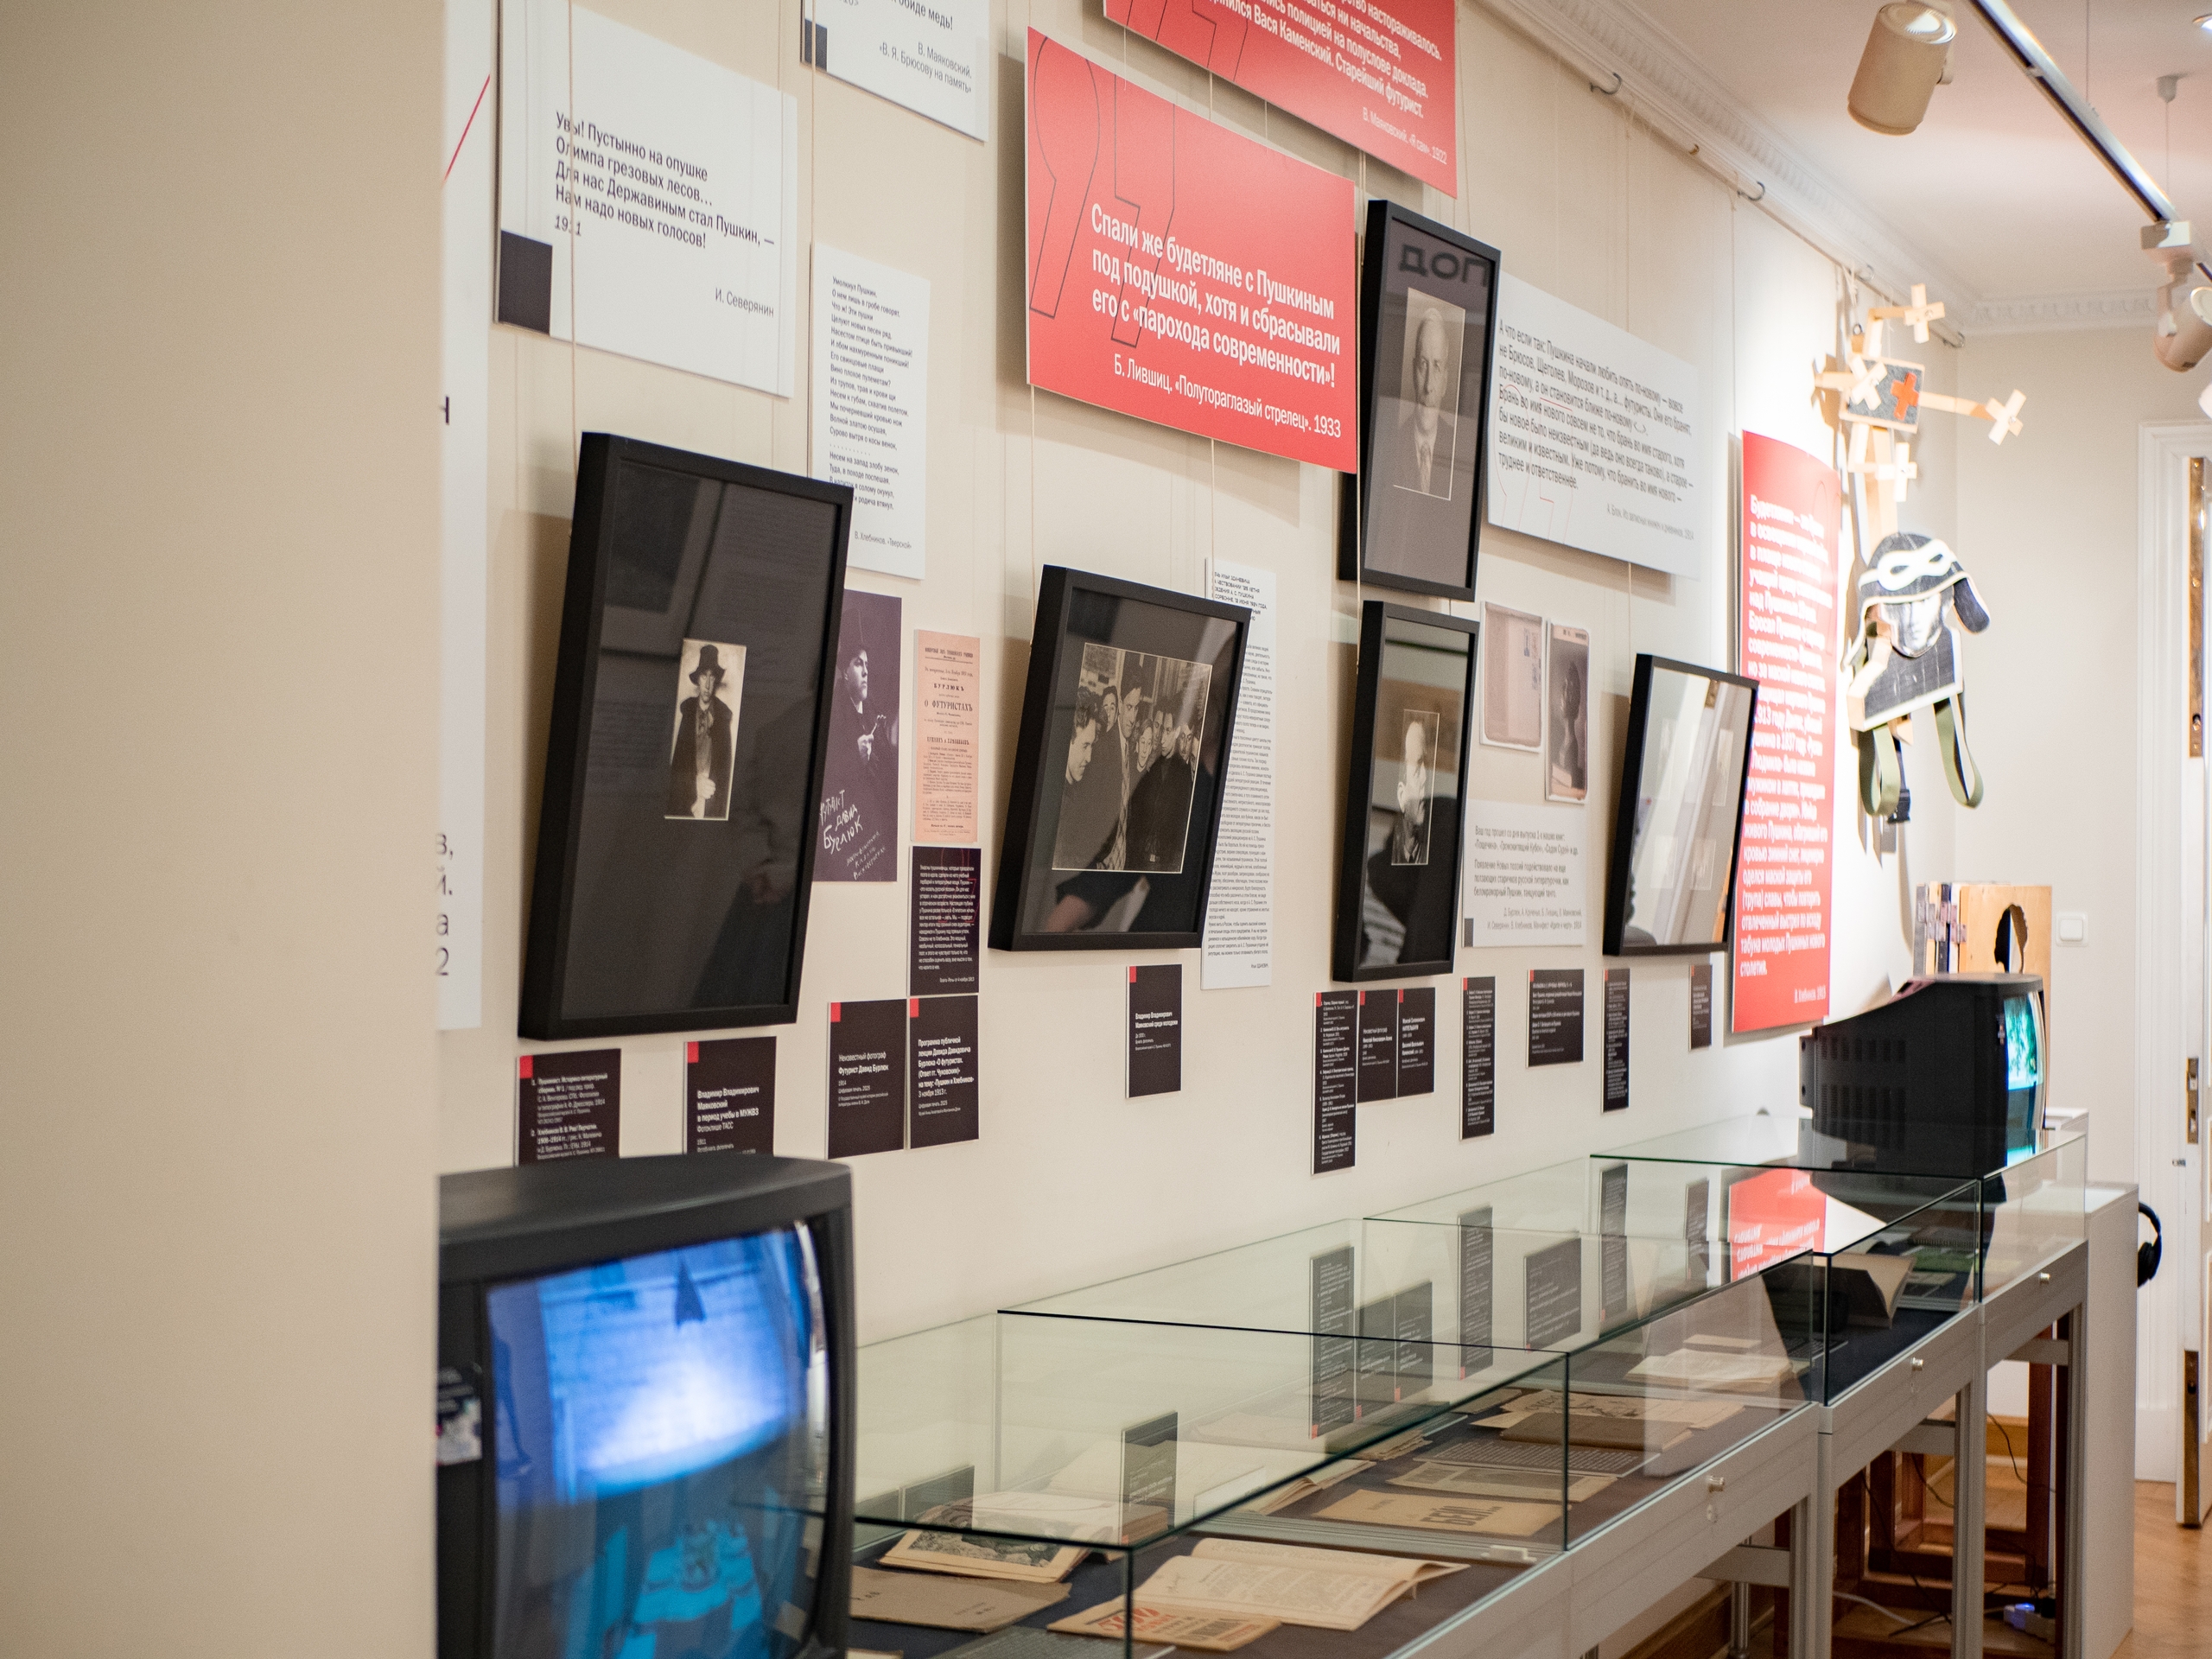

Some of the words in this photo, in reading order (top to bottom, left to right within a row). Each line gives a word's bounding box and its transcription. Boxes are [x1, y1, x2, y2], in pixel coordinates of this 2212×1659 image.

[1287, 3, 1332, 41] полицией
[1334, 30, 1345, 49] на
[1346, 38, 1391, 74] полуслове
[1392, 66, 1428, 99] доклада.
[1336, 7, 1349, 24] ни
[1350, 16, 1402, 61] начальства,
[1367, 3, 1442, 61] настораживалось.
[1254, 7, 1278, 35] Вася
[1280, 21, 1334, 67] Каменский.
[1335, 53, 1384, 96] Старейший
[1385, 82, 1424, 118] футурист.
[588, 123, 646, 159] Пустынно
[649, 149, 663, 165] на
[665, 156, 708, 181] опушке
[1363, 106, 1370, 123] В.
[1370, 111, 1409, 144] Маяковский.
[607, 158, 664, 189] грезовых
[555, 214, 582, 237] 191
[583, 174, 604, 192] нас
[607, 178, 686, 219] Державиным
[689, 210, 713, 228] стал
[716, 214, 760, 245] Пушкин,
[585, 198, 614, 219] надо
[618, 208, 654, 232] новых
[658, 221, 706, 249] голосов!
[1091, 203, 1138, 249] Спали
[1141, 231, 1163, 258] же
[1166, 236, 1243, 288] будетляне
[1245, 271, 1254, 292] с
[1257, 269, 1334, 320] Пушкиным
[715, 288, 724, 303] И.
[726, 291, 774, 317] Северянин
[1093, 249, 1121, 286] под
[1124, 262, 1202, 315] подушкой,
[1205, 292, 1236, 322] хотя
[1240, 305, 1249, 327] и
[1252, 302, 1340, 355] сбрасывали
[1092, 289, 1118, 318] его
[1121, 299, 1129, 322] с
[1133, 306, 1210, 352] «парохода
[1213, 332, 1335, 388] современности»!
[1115, 353, 1125, 377] Б.
[1127, 358, 1173, 395] Лившиц.
[1175, 374, 1262, 417] «Полутораглазый
[1264, 404, 1312, 433] стрелец».
[1313, 415, 1341, 438] 1933
